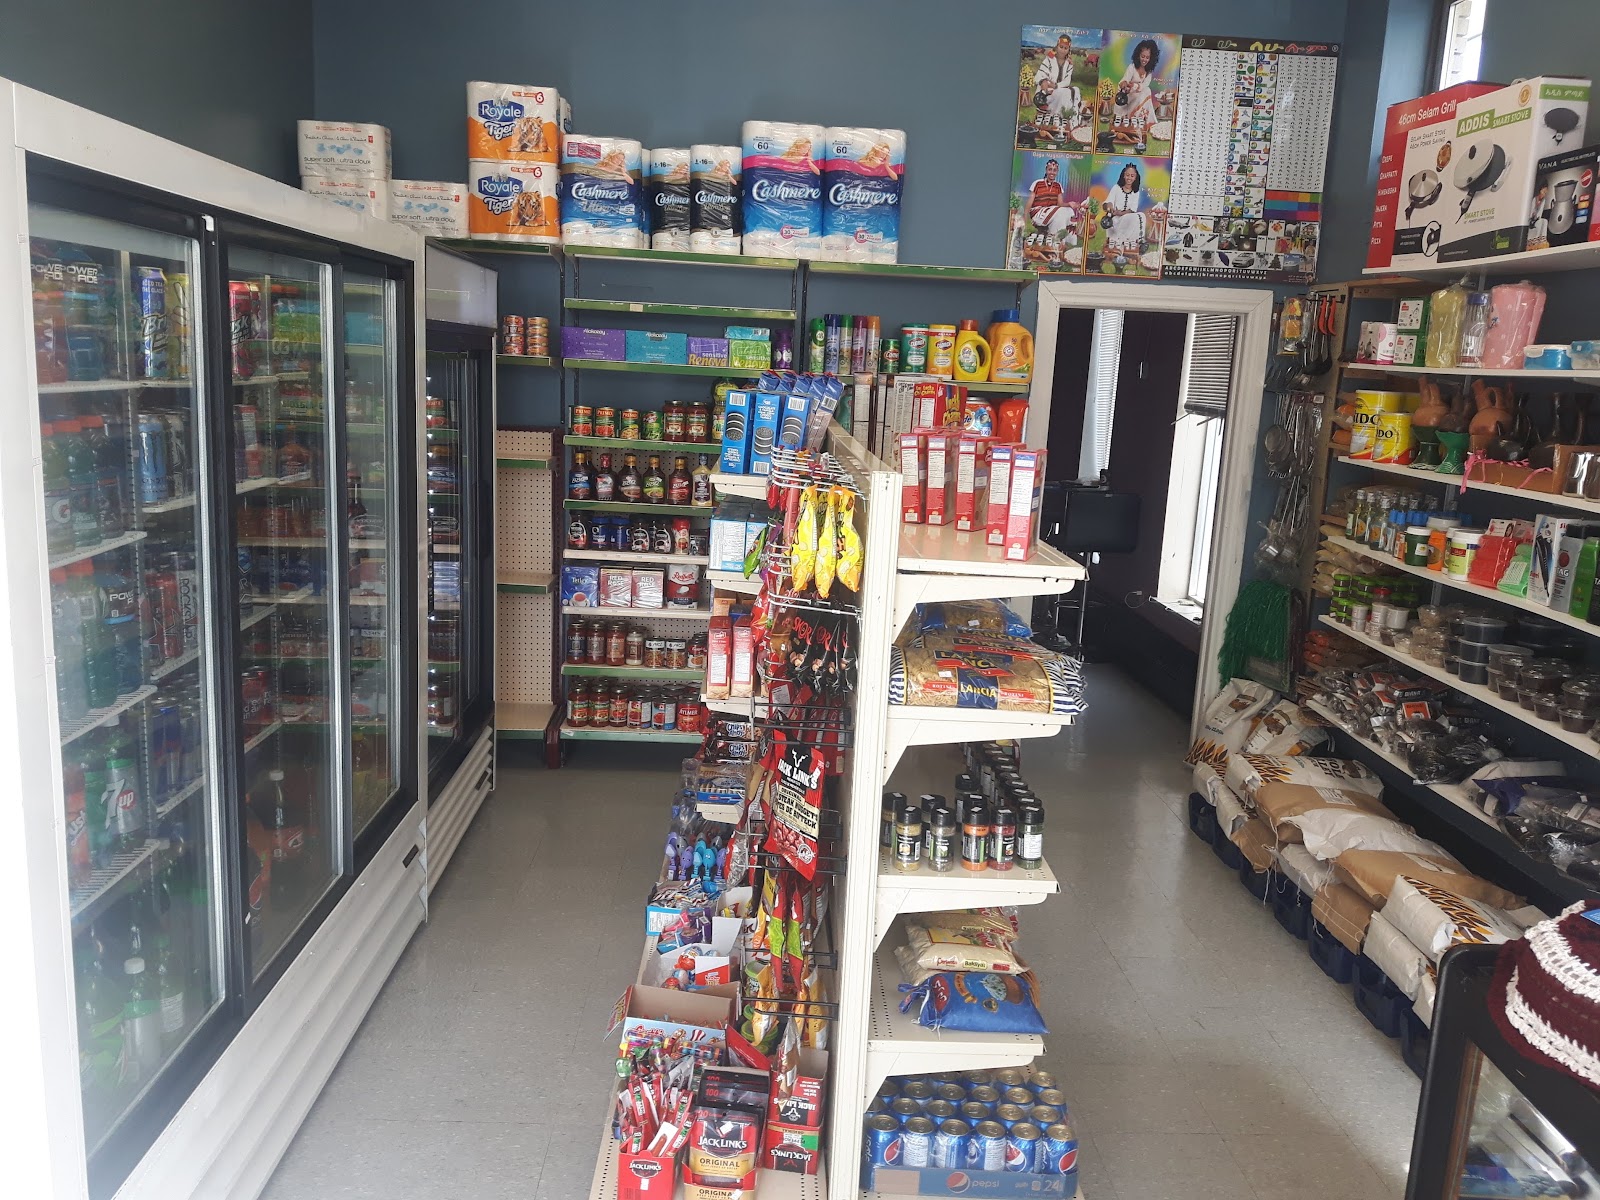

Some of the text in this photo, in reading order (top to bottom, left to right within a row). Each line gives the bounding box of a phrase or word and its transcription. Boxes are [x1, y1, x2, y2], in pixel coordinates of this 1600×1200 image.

[482, 104, 522, 120] Royale
[1418, 106, 1440, 120] Selam
[1440, 99, 1457, 114] Grill
[1458, 110, 1530, 134] ADDIS SMART STOVE
[484, 121, 516, 140] Tiger
[757, 142, 769, 150] 60
[836, 146, 848, 154] 60
[481, 180, 520, 196] Royale
[572, 182, 629, 200] Cashmere
[752, 180, 821, 200] Cashmere
[828, 183, 898, 206] Cashmere
[655, 192, 690, 206] Cashmer
[694, 190, 738, 204] Cashmere
[483, 197, 514, 216] Tiger
[940, 651, 995, 668] LANCI
[960, 683, 998, 698] LANCIA
[778, 793, 794, 808] STEAK
[793, 809, 817, 830] BIFTECK
[698, 1136, 720, 1148] JACK
[700, 1158, 740, 1168] ORIGINAL
[793, 1152, 812, 1162] JACK
[699, 1188, 732, 1197] ORIGINA
[972, 1180, 1000, 1190] pepsi
[1044, 1180, 1059, 1192] 24
